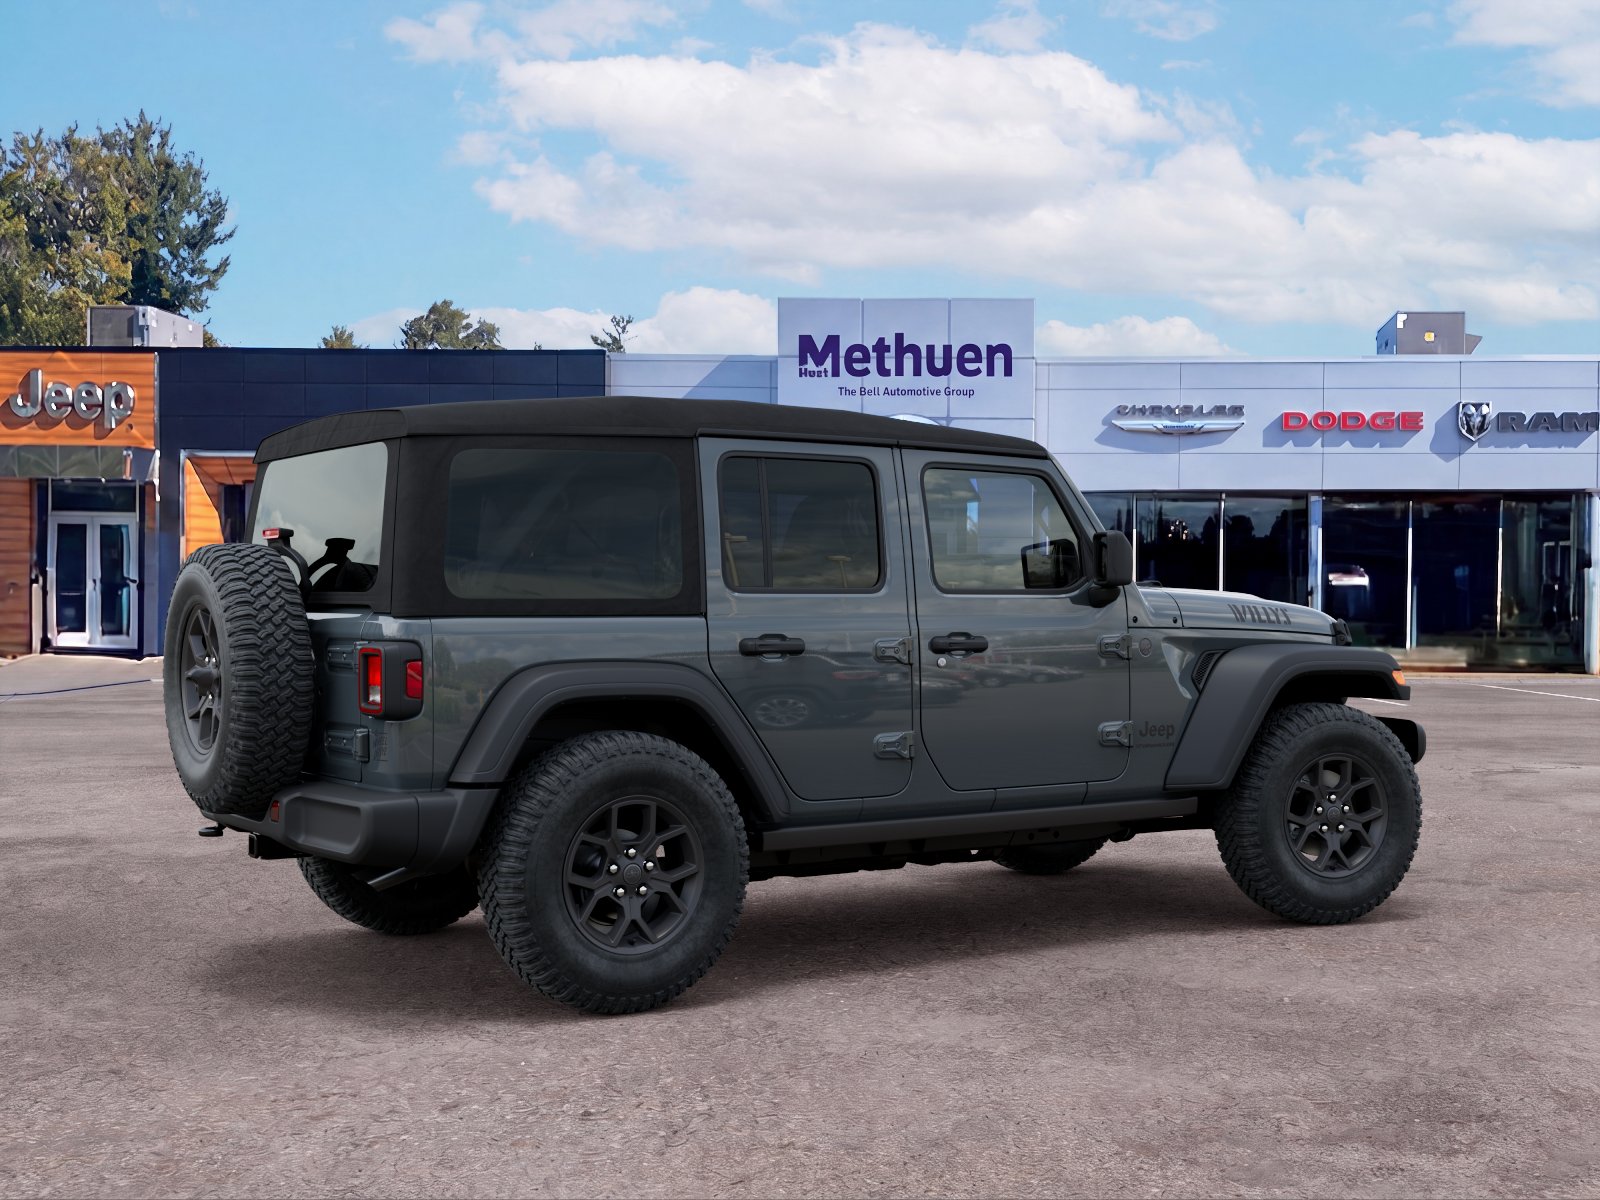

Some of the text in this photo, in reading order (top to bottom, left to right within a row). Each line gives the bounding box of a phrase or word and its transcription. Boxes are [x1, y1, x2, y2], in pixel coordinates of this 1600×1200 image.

[798, 332, 1013, 377] Methuen
[9, 368, 136, 429] Jeep
[838, 387, 975, 398] The Bell Automotive Group
[1282, 411, 1424, 431] DODGE
[1498, 411, 1600, 432] RAM
[1227, 604, 1292, 625] WILLYS
[1139, 721, 1175, 739] Jeep
